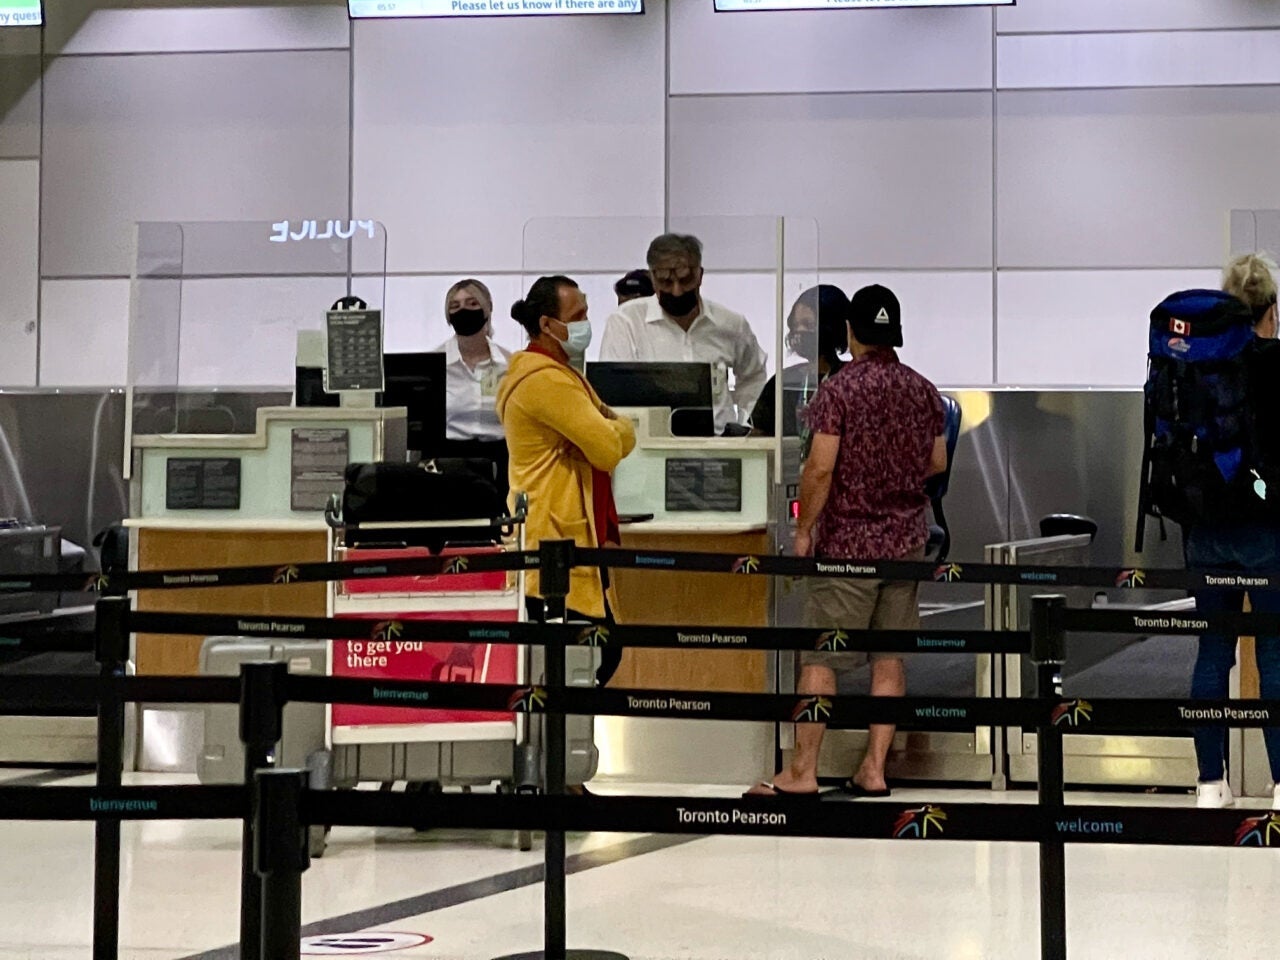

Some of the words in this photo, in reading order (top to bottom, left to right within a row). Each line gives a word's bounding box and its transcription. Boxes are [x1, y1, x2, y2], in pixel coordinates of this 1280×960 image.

[451, 0, 486, 11] Please
[489, 0, 503, 10] let
[507, 1, 520, 10] us
[523, 0, 552, 9] know
[598, 0, 615, 9] are
[618, 0, 637, 11] any
[816, 563, 843, 573] Toronto
[846, 564, 876, 574] Pearson
[1021, 571, 1057, 581] welcome
[1205, 575, 1235, 585] Toronto
[1237, 576, 1268, 587] Pearson
[238, 620, 270, 632] Toronto
[271, 621, 305, 633] Pearson
[1133, 617, 1169, 628] Toronto
[1171, 617, 1208, 629] Pearson
[469, 628, 510, 639] welcome
[677, 632, 710, 643] Toronto
[712, 633, 747, 644] Pearson
[347, 640, 363, 653] to
[366, 641, 391, 655] get
[395, 640, 423, 653] you
[917, 636, 965, 648] bienvenue
[347, 653, 387, 668] there
[373, 688, 428, 701] bienvenue
[627, 696, 667, 710] Toronto
[669, 697, 710, 711] Pearson
[915, 707, 966, 718] welcome
[1178, 707, 1222, 719] Toronto
[1224, 707, 1269, 720] Pearson
[89, 797, 158, 812] bienvenue
[676, 807, 729, 824] Toronto
[732, 809, 787, 826] Pearson
[1056, 819, 1123, 834] welcome
